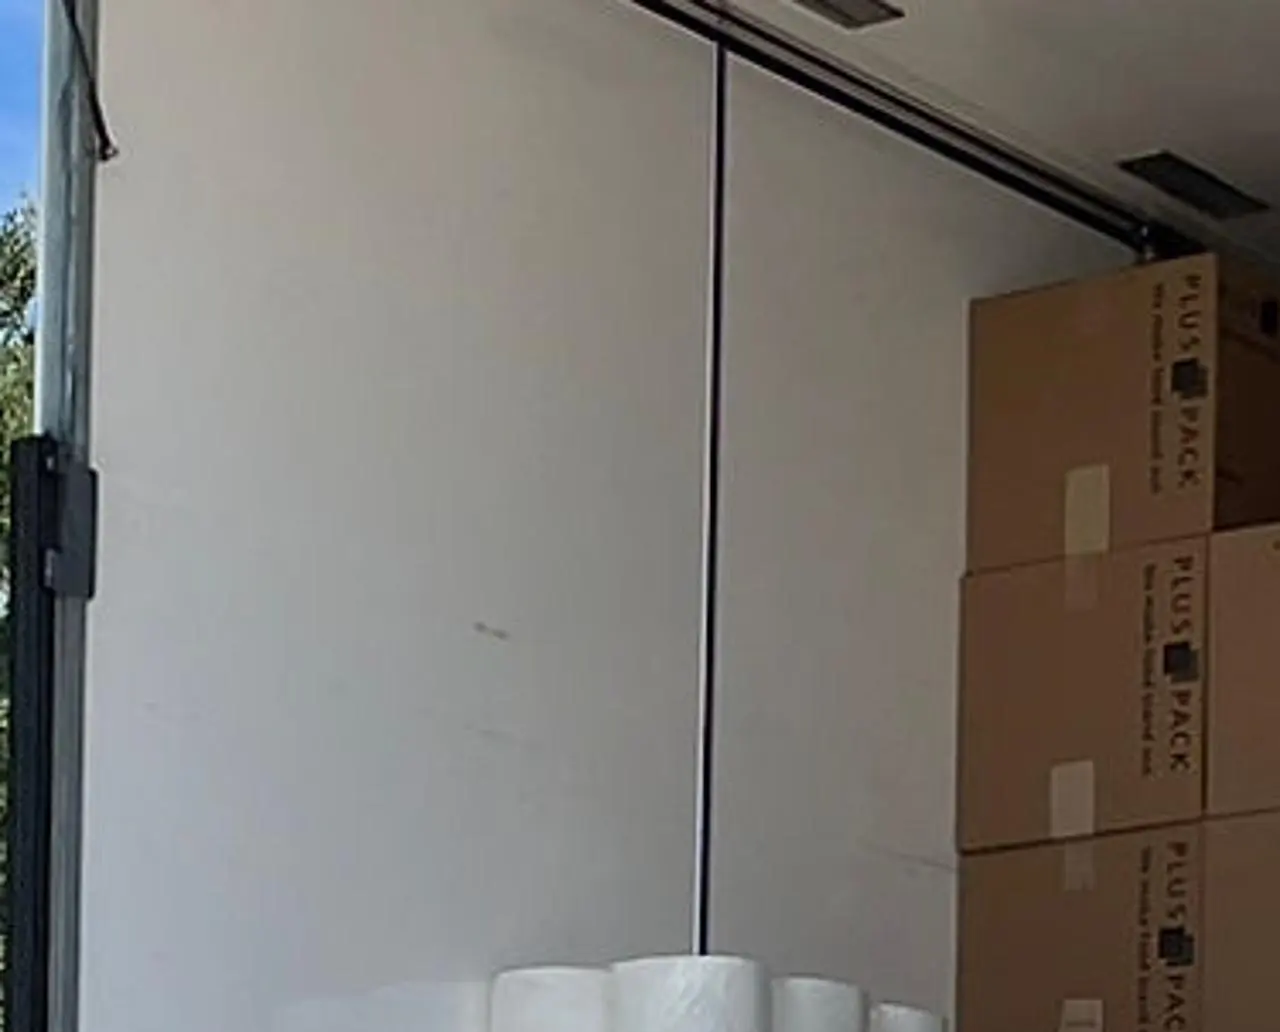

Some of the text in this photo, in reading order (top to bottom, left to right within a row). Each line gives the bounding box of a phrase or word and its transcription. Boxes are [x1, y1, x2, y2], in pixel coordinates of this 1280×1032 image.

[1177, 274, 1203, 489] PLUS PACK
[1169, 555, 1194, 771] PLUS PACK
[1167, 841, 1187, 920] PLUS
